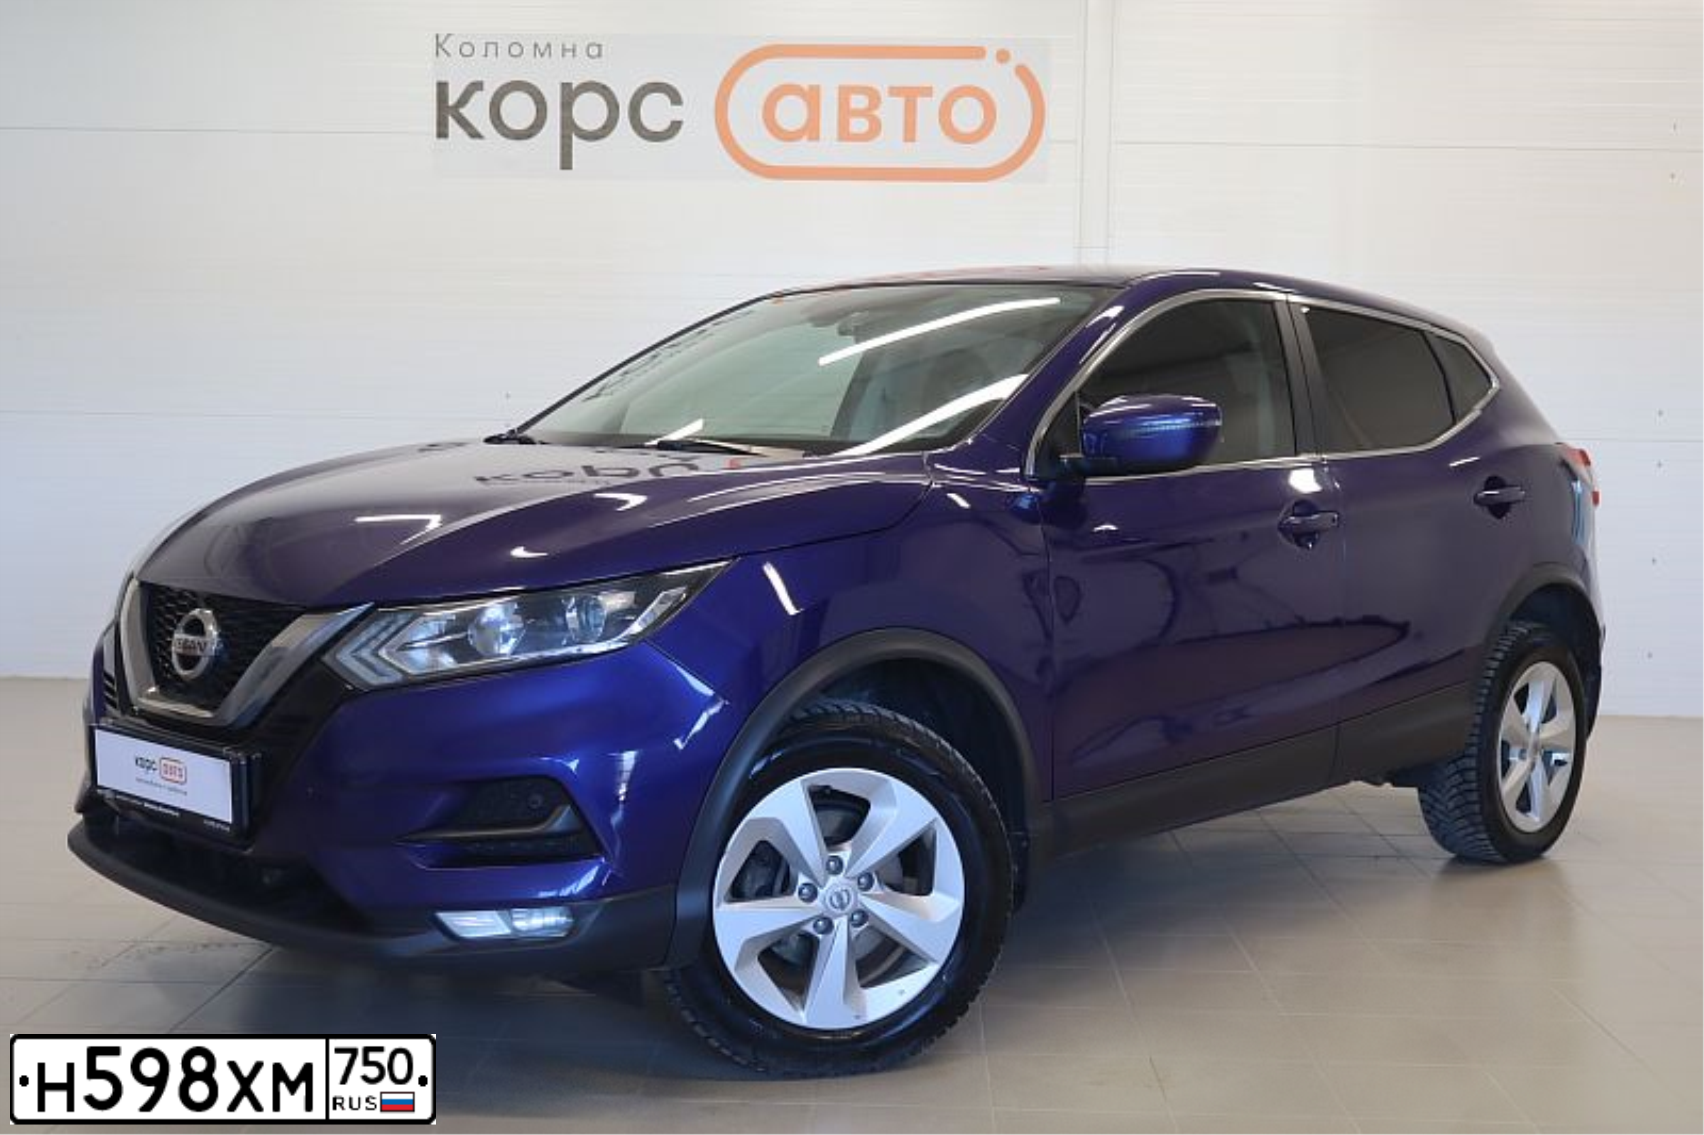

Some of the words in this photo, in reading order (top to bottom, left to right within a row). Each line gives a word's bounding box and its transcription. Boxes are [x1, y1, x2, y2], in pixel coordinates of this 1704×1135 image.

[436, 33, 604, 59] Коломна
[435, 80, 684, 170] корс
[762, 83, 997, 144] авто
